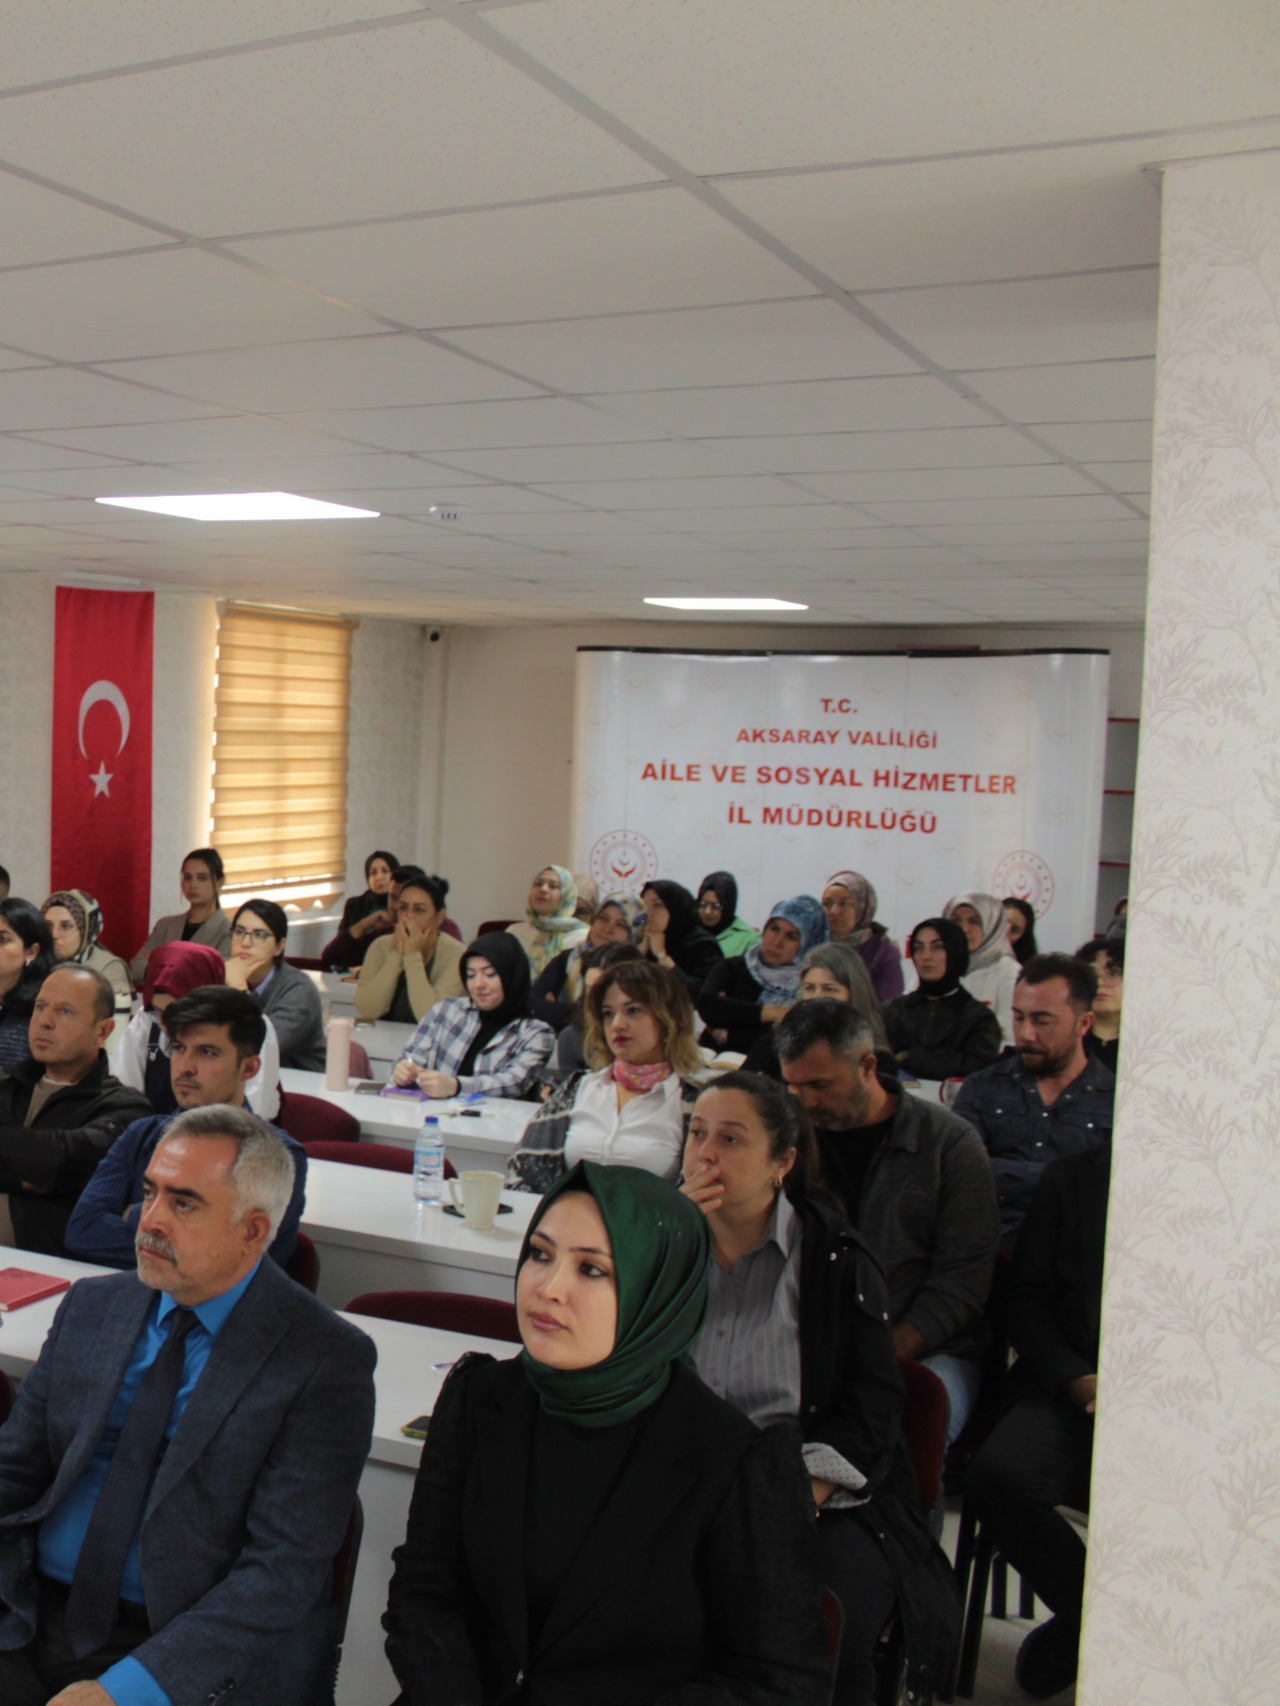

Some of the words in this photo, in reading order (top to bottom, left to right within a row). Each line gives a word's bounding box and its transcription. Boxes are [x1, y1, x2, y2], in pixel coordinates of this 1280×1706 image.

[820, 698, 858, 714] T.C.
[736, 728, 840, 745] AKSARAY
[848, 728, 938, 749] VALİLİĞİ
[641, 759, 702, 782] AİLE
[712, 764, 747, 784] VE
[756, 765, 863, 787] SOSYAL
[873, 765, 1018, 795] HİZMETLER
[728, 801, 752, 824] İL
[762, 803, 937, 834] MÜDÜRLÜĞÜ
